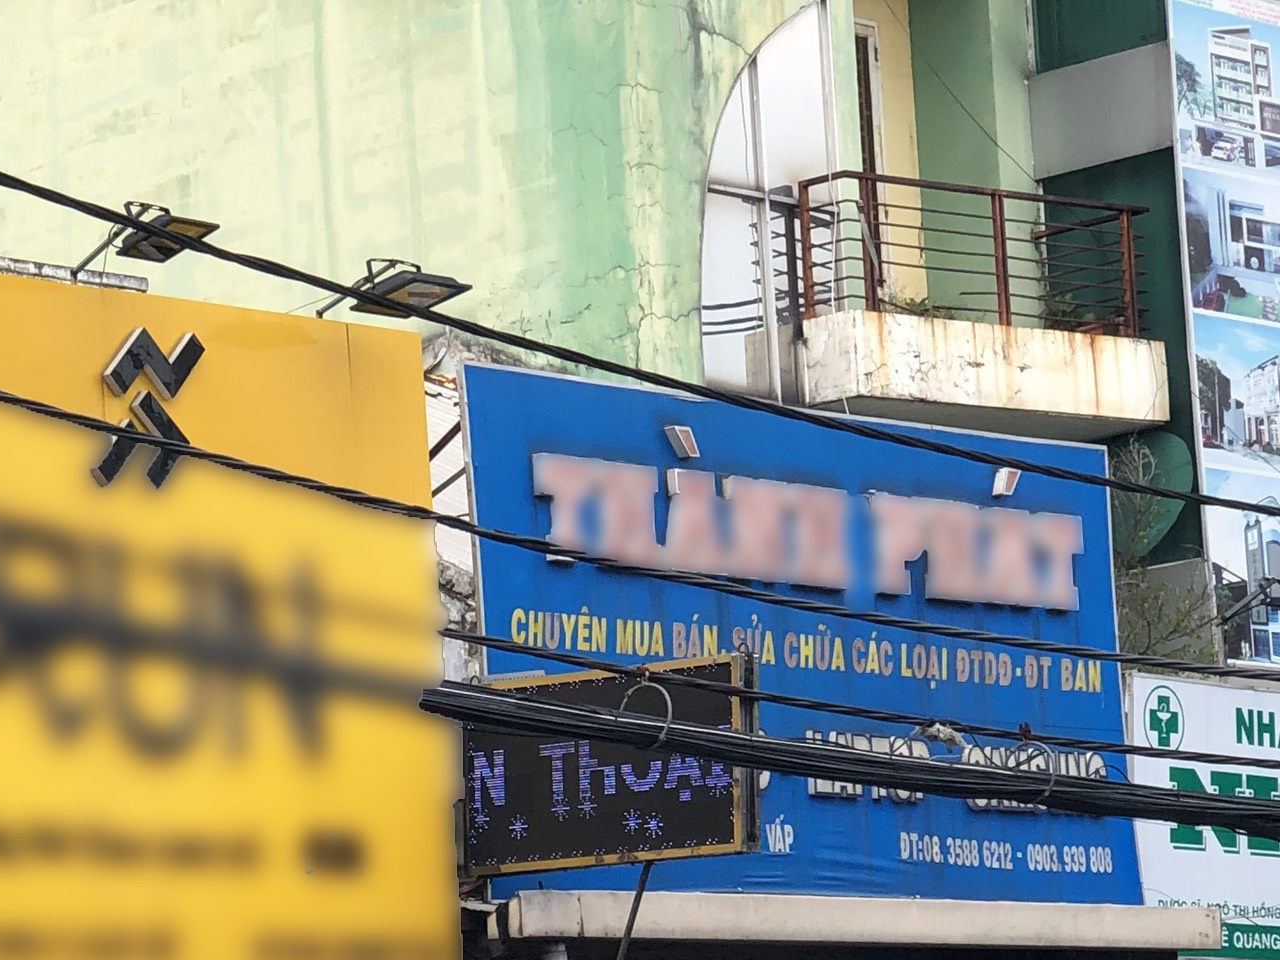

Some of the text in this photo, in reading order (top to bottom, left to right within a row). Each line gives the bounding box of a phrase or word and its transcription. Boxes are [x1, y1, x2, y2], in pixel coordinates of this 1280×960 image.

[510, 605, 607, 653] CHUYÊN
[615, 618, 664, 657] MUA
[732, 613, 775, 665] SỬA
[784, 624, 846, 671] CHỮA
[852, 631, 894, 676] CÁC
[900, 643, 948, 689] LOẠI
[1236, 707, 1280, 750] NH
[765, 814, 794, 853] VẤP
[947, 837, 980, 867] 3588
[983, 840, 1013, 870] 6212
[1027, 843, 1062, 873] 0903.
[1063, 846, 1086, 873] 939
[1089, 847, 1113, 873] 808
